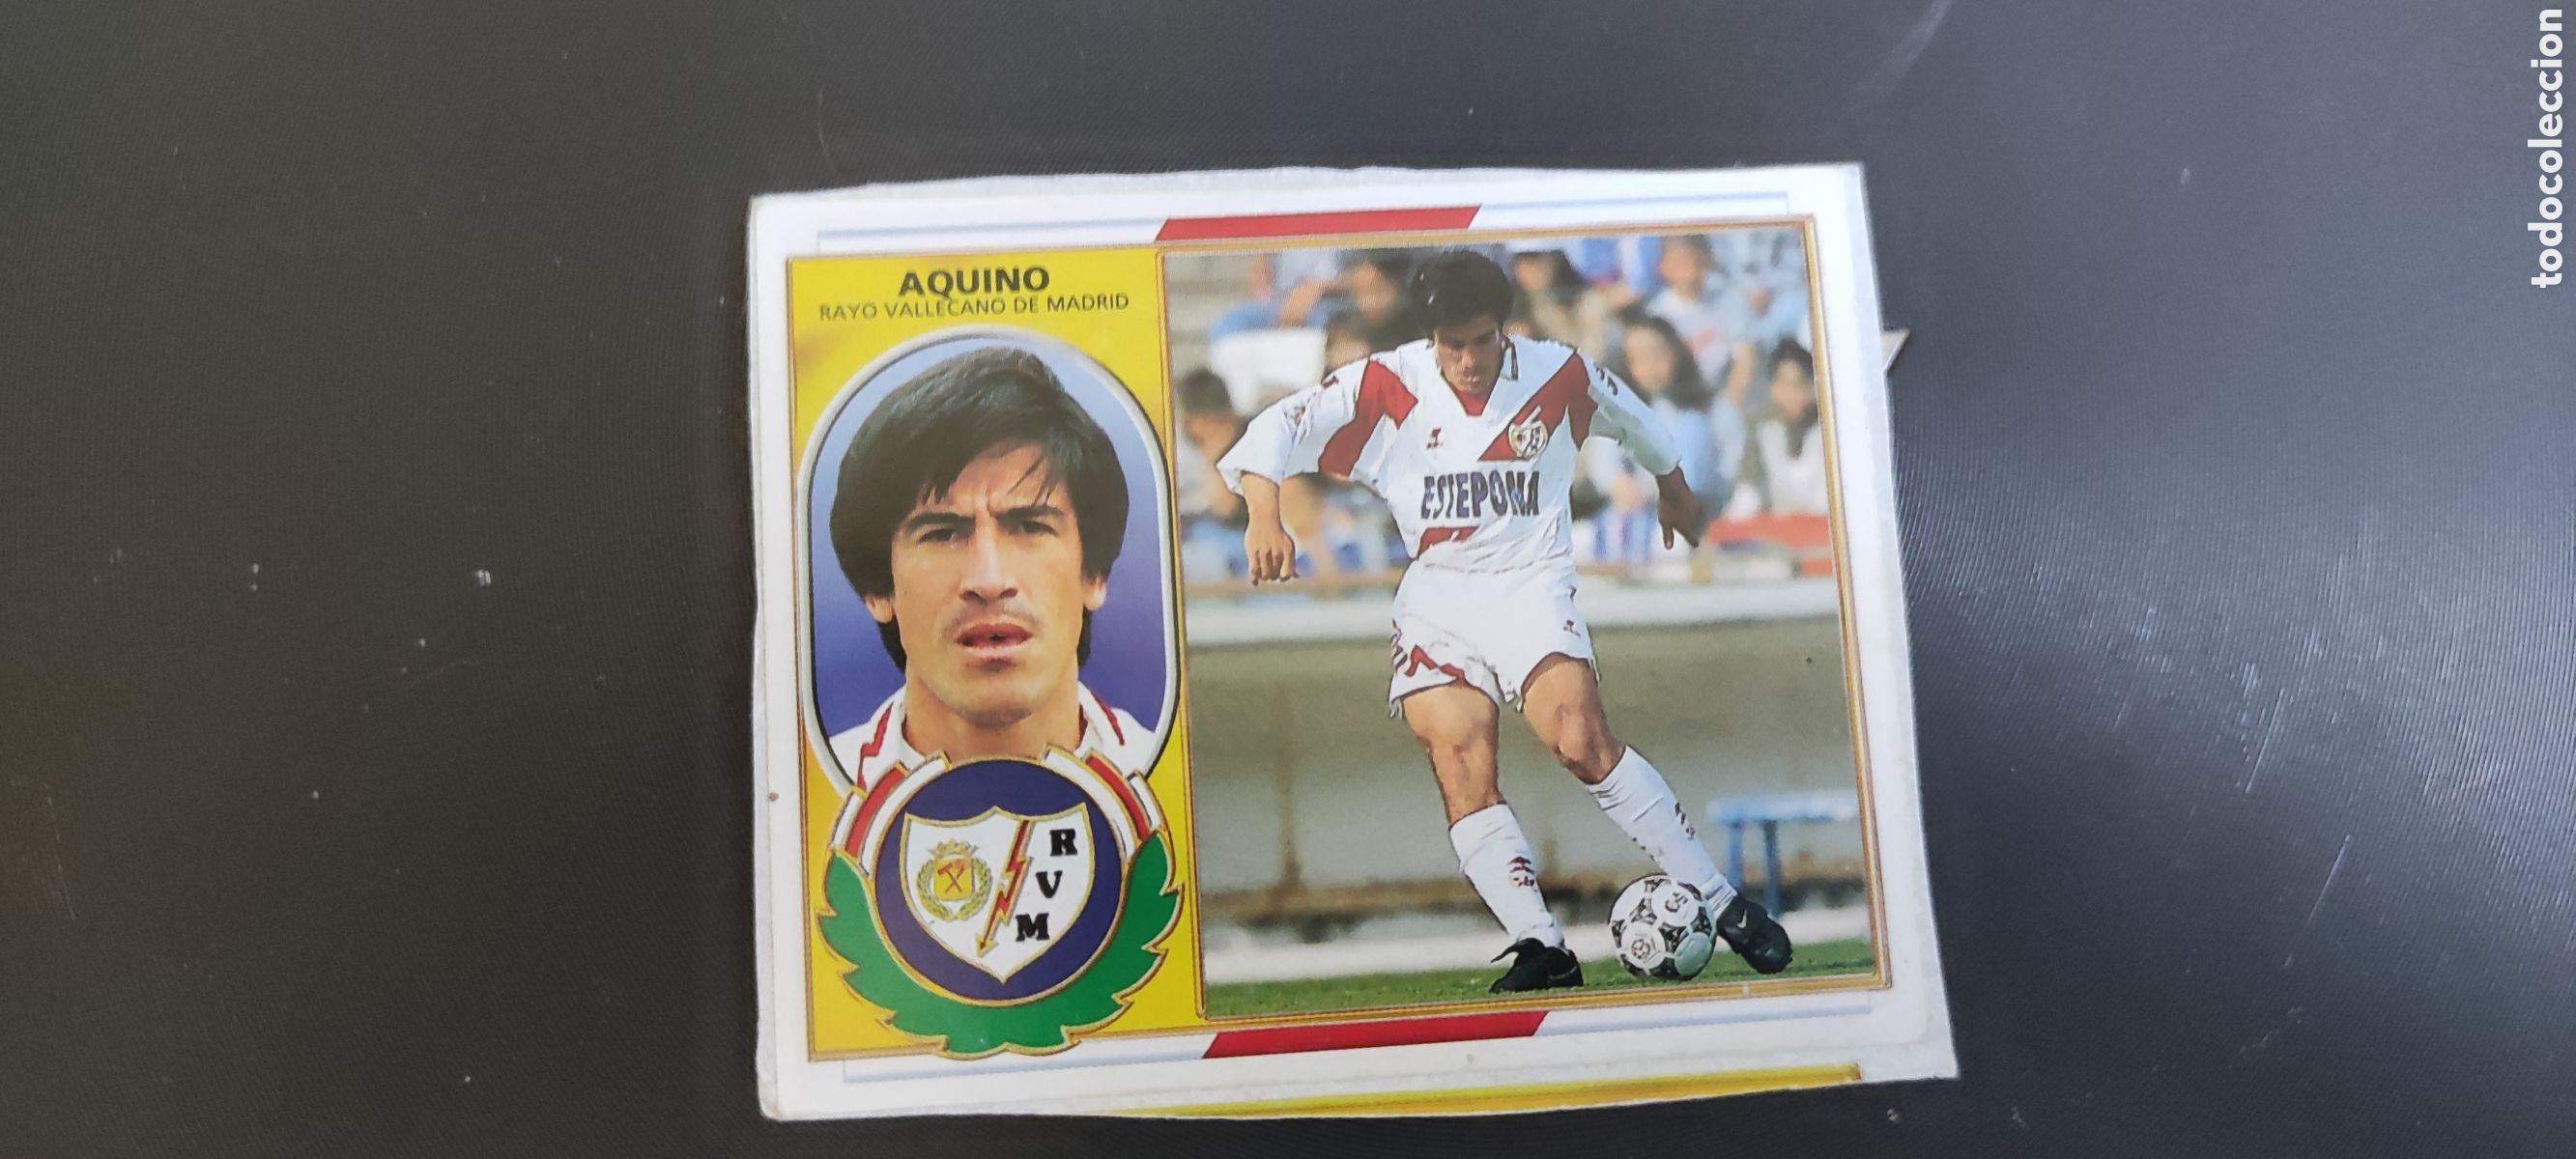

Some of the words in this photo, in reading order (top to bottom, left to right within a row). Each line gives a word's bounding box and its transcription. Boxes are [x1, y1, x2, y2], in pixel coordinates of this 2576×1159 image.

[898, 266, 1049, 299] AQUINO
[819, 303, 877, 321] RAYO
[885, 297, 1006, 319] VALLECANO
[1014, 294, 1040, 314] DE
[1046, 293, 1130, 312] MADRID
[1421, 469, 1540, 520] ESTEPONA
